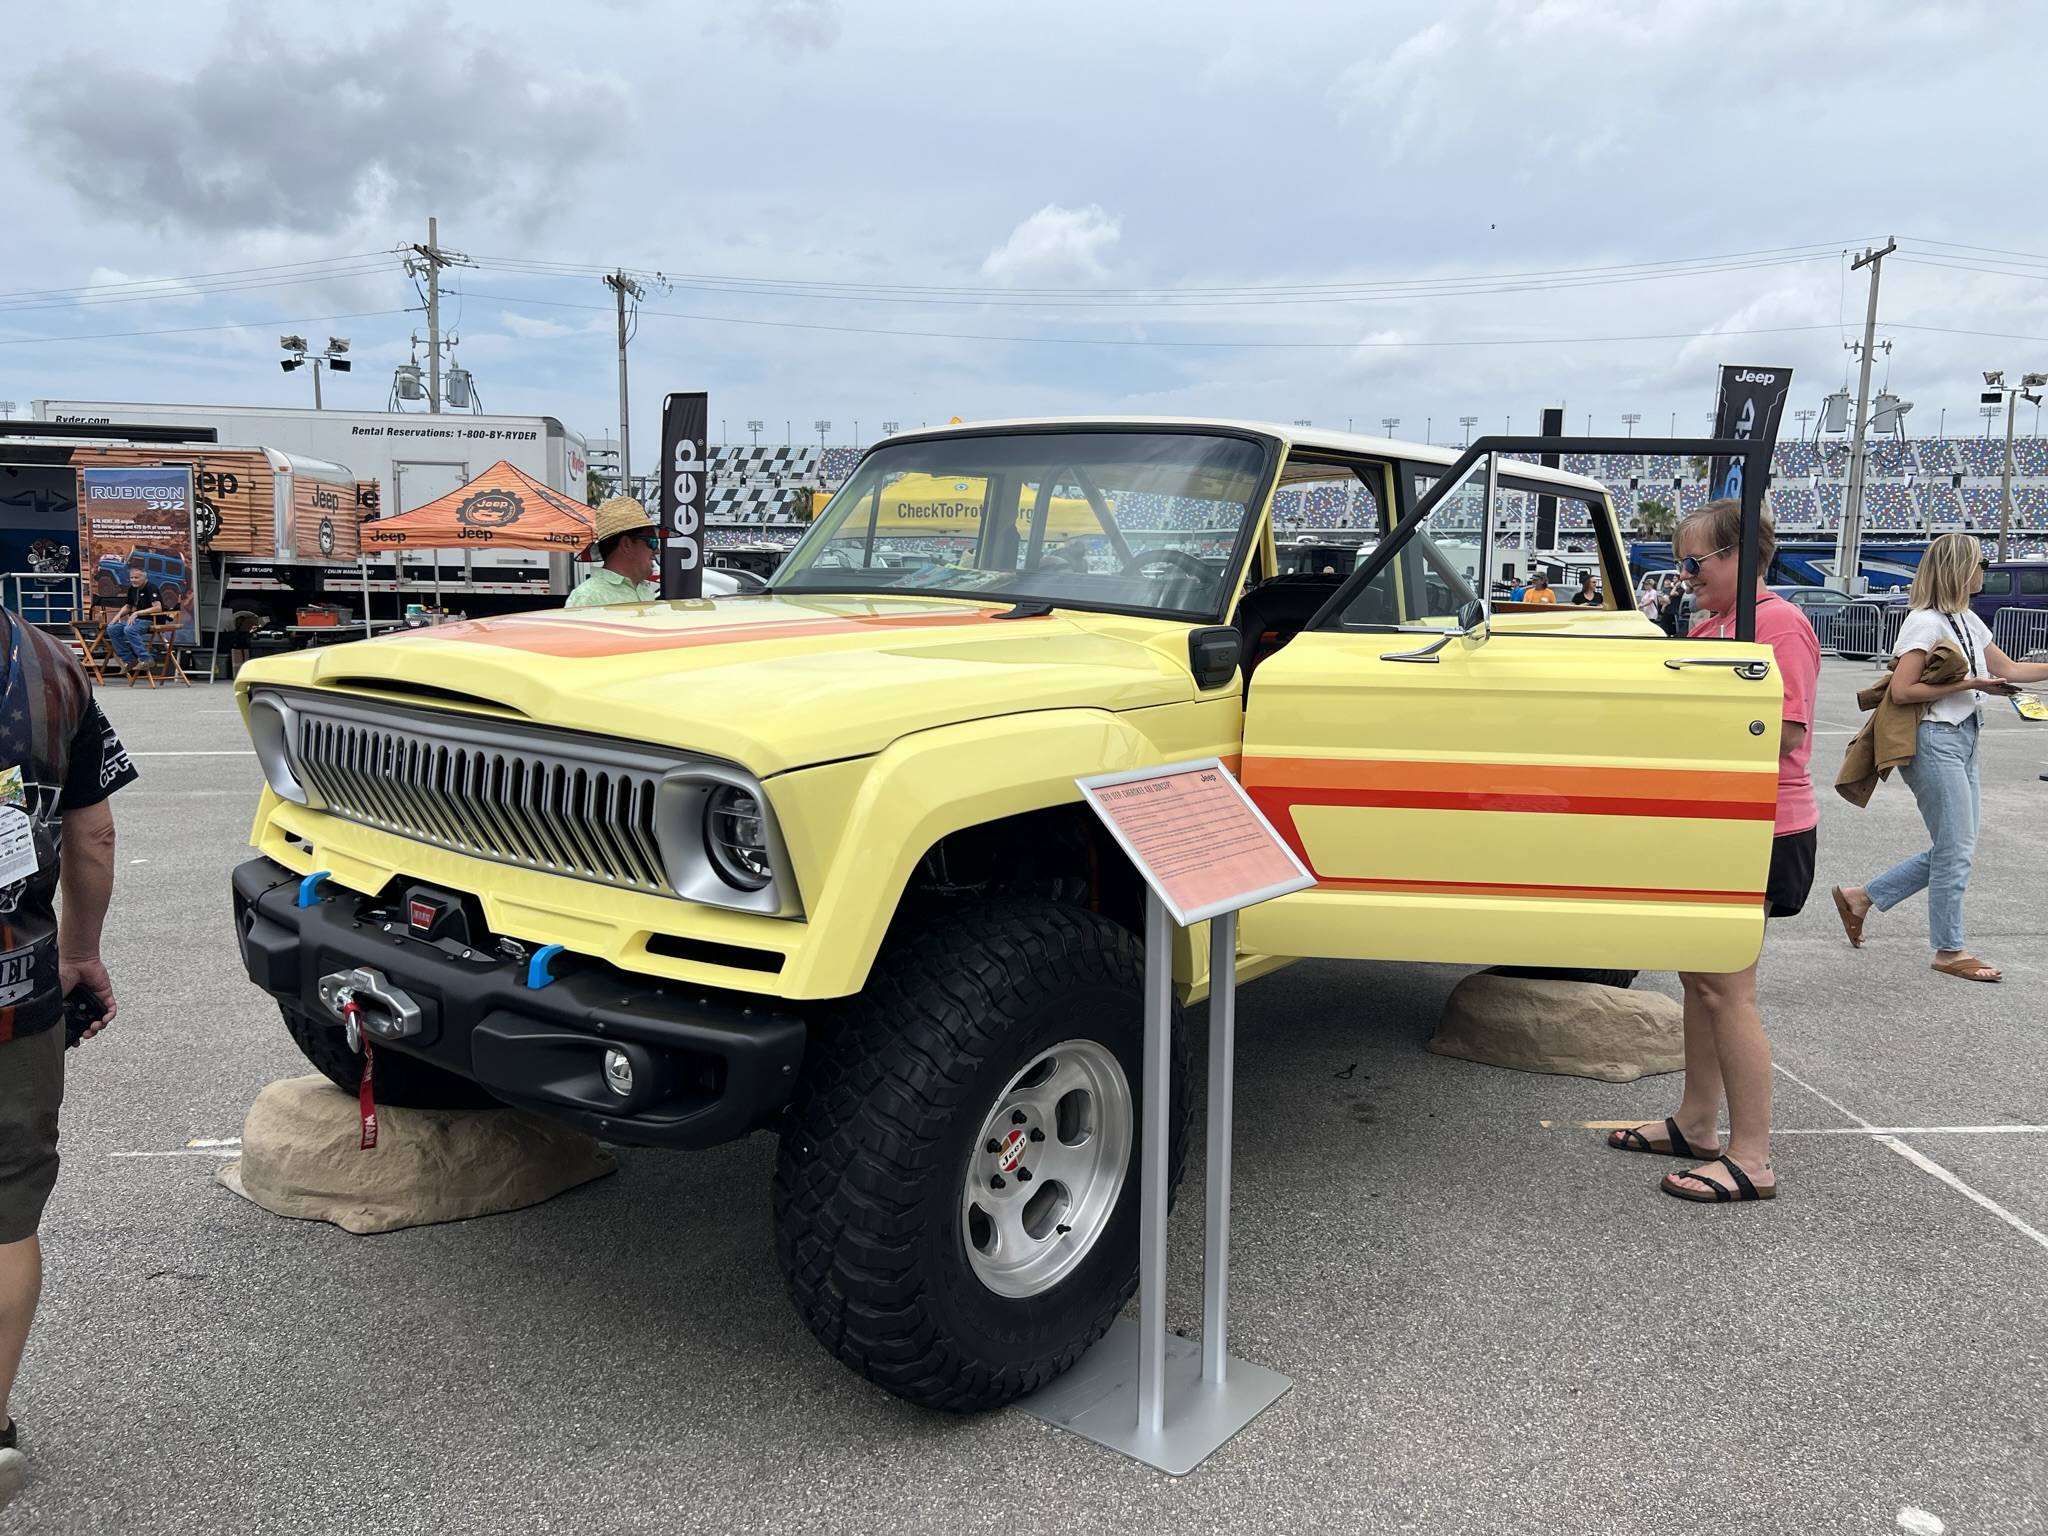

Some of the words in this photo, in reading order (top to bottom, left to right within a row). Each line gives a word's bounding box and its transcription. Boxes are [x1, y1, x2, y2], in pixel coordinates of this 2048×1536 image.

[1735, 369, 1775, 386] Jeep
[351, 426, 384, 436] Rental
[386, 427, 454, 438] Reservations:
[457, 430, 537, 441] 1-800-BY-RYDER
[91, 486, 185, 500] RUBICON
[312, 484, 339, 515] Jeep
[147, 501, 185, 510] 392
[476, 500, 509, 508] Jeep
[666, 439, 705, 570] Jeep
[370, 529, 407, 544] Jeep
[457, 527, 493, 541] Jeep
[543, 532, 580, 546] Jeep
[1002, 1137, 1025, 1166] Jeep
